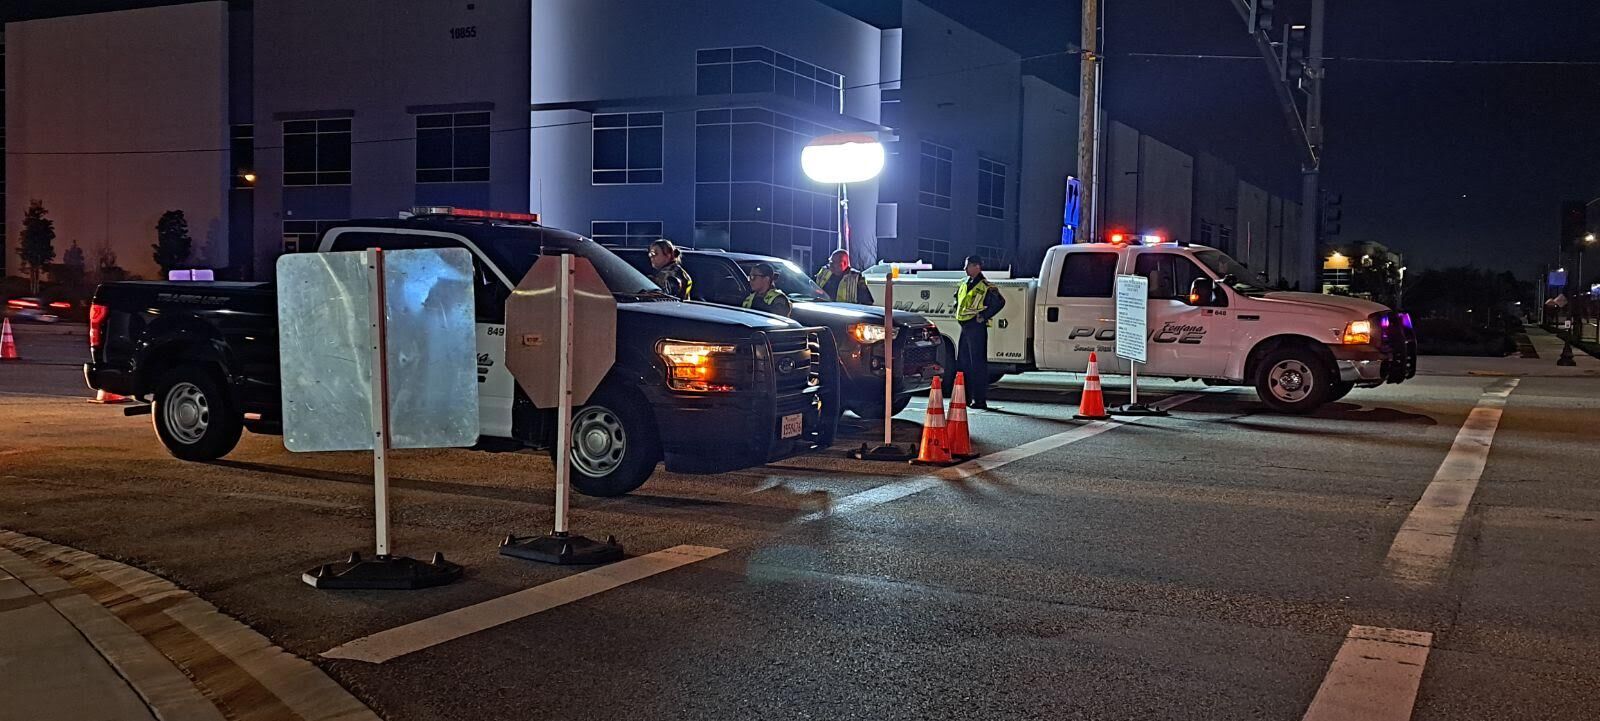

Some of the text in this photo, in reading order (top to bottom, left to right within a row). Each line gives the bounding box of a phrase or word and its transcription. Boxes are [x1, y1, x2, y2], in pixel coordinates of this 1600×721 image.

[450, 26, 476, 39] 10855
[487, 327, 504, 336] 849
[1162, 321, 1204, 335] Fontana
[1068, 326, 1207, 344] POCE
